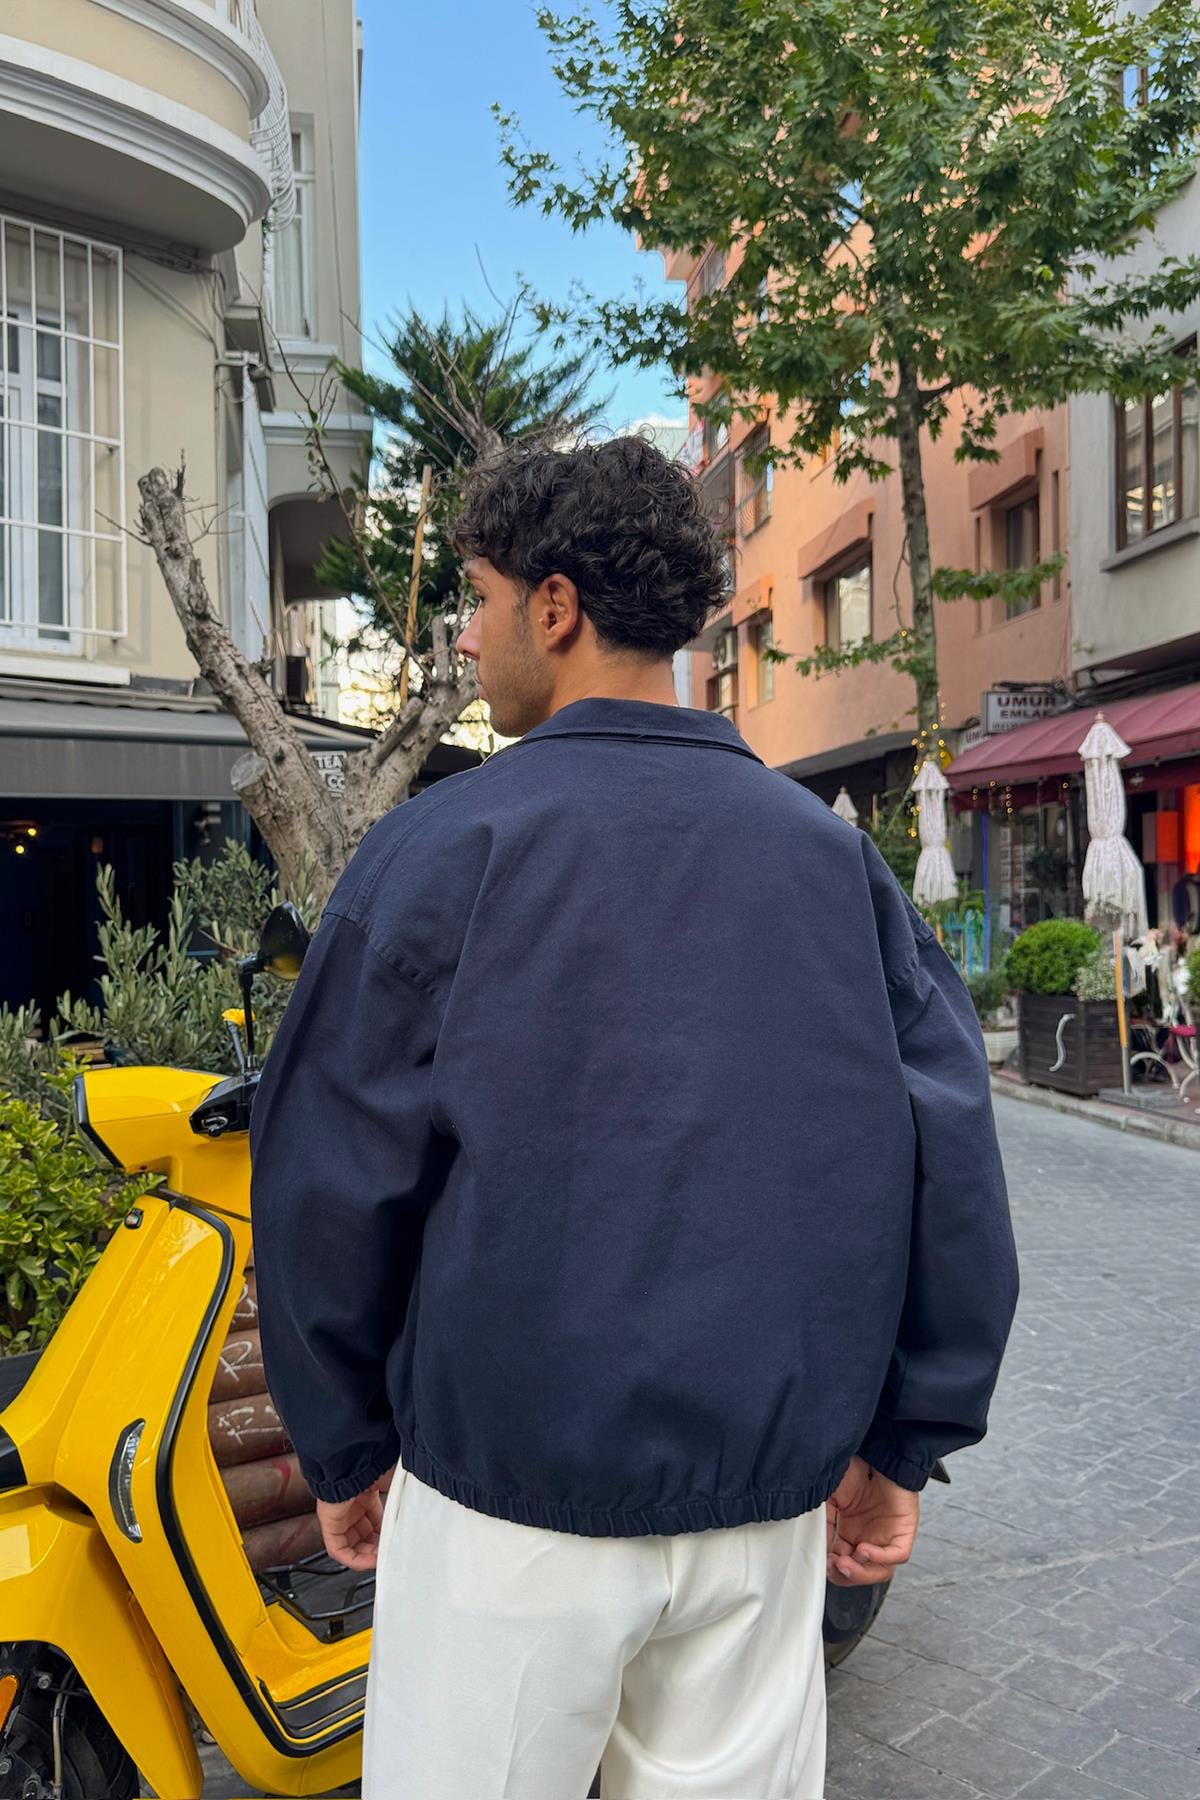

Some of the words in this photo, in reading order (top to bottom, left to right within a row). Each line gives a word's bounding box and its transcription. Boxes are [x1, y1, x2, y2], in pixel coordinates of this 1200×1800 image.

[997, 696, 1057, 707] UMUR
[1000, 709, 1051, 719] EMLAK
[316, 756, 343, 768] TEA
